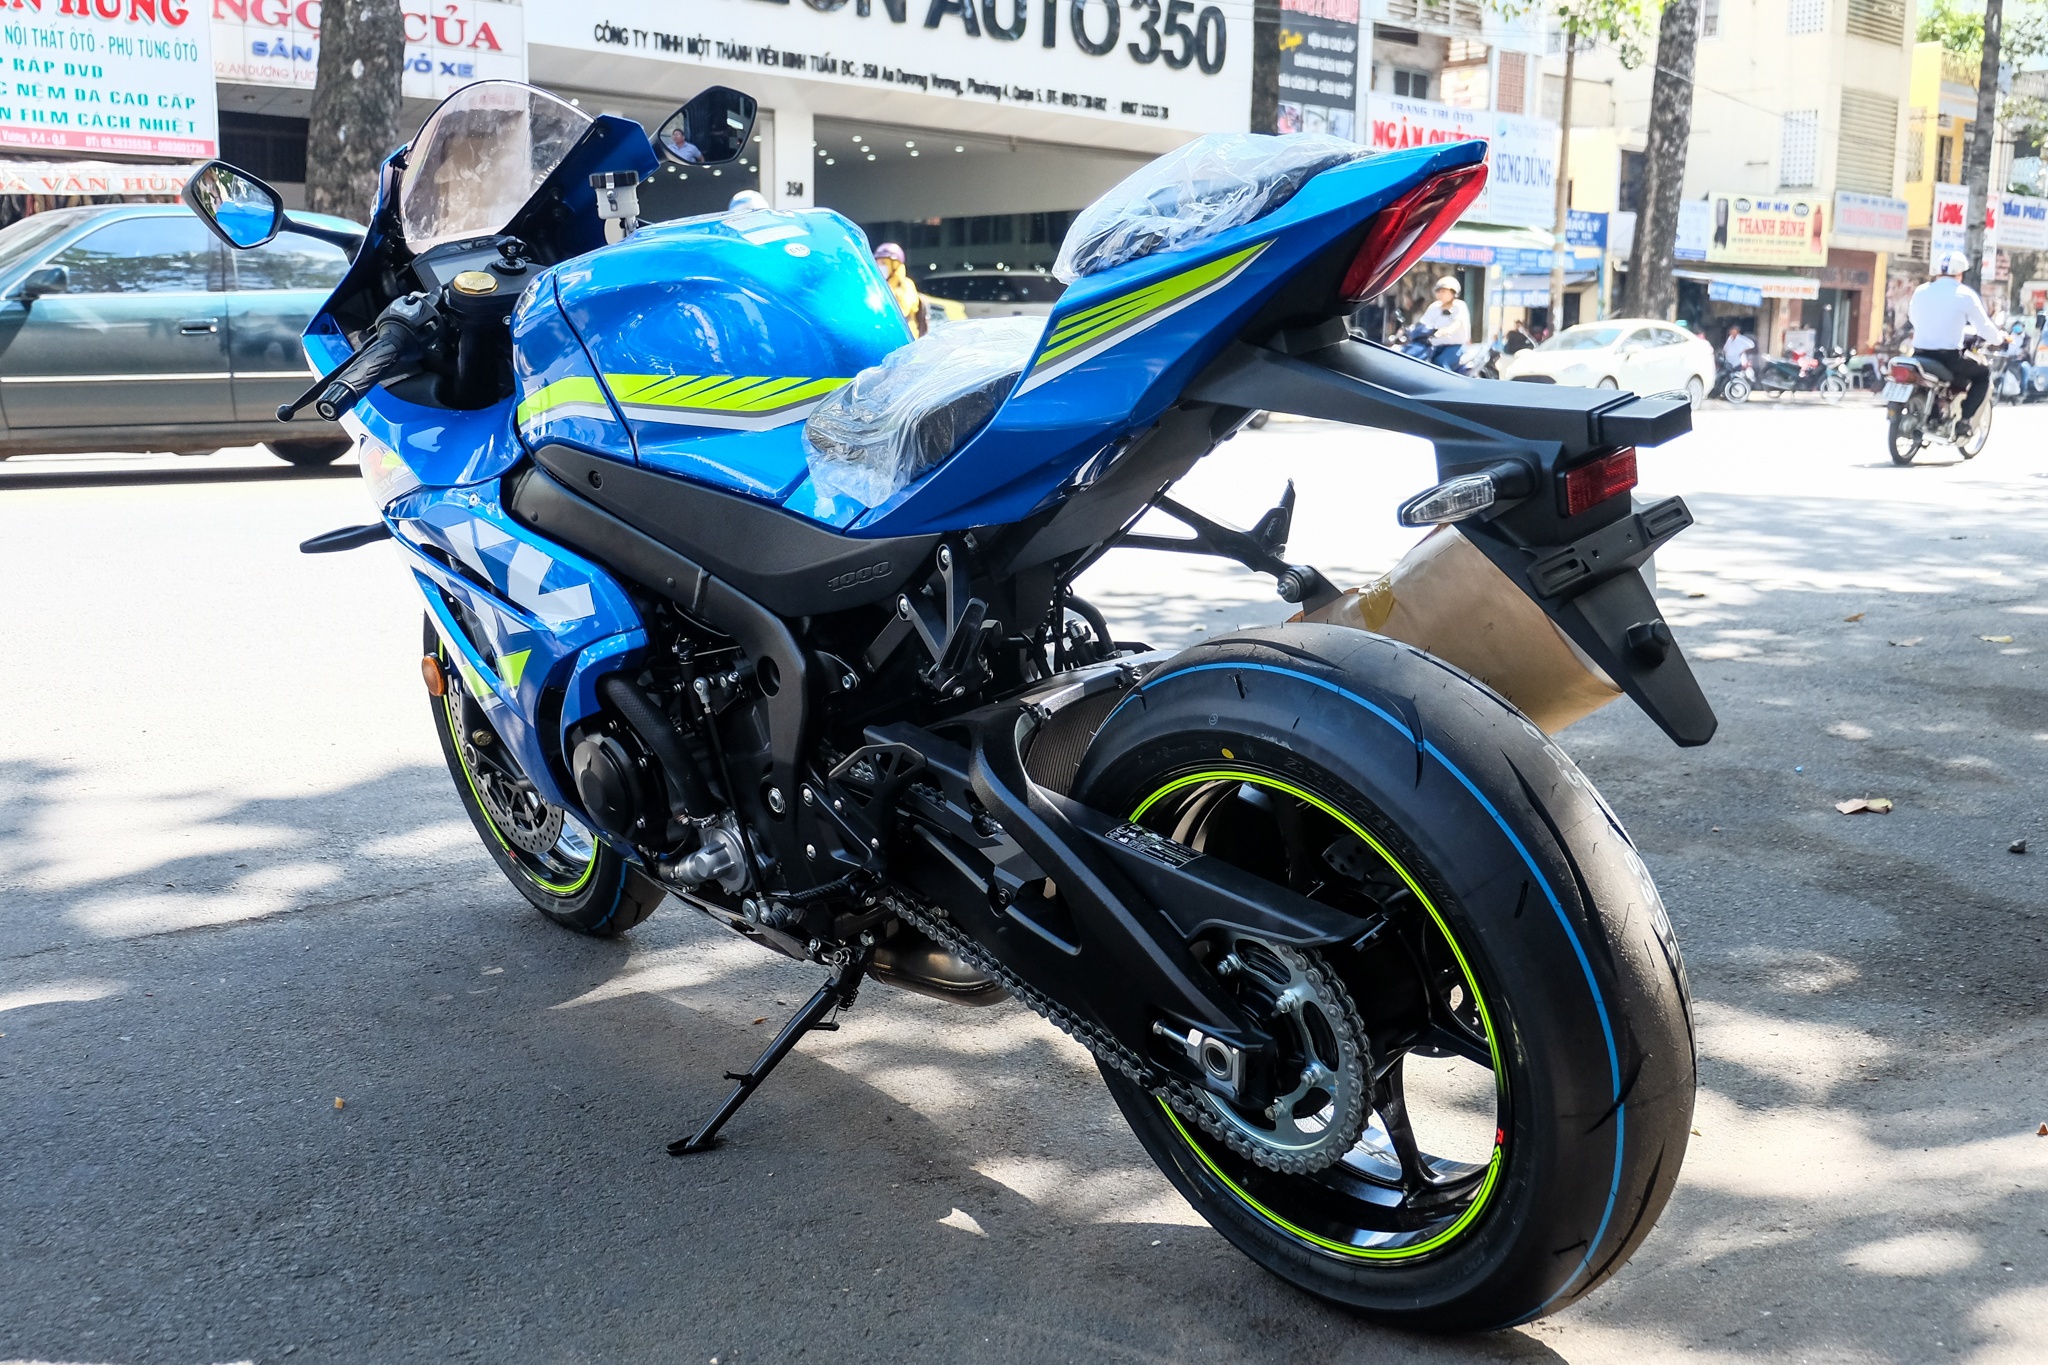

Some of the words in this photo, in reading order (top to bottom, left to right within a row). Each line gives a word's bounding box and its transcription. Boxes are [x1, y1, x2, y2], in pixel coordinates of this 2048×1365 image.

[5, 21, 27, 49] NỘI
[32, 21, 64, 49] THẤT
[70, 27, 95, 52] ÔTÔ
[109, 36, 133, 60] PHỤ
[138, 34, 171, 60] TÙNG
[174, 37, 198, 62] ÔTÔ
[403, 4, 503, 51] CỦA
[594, 20, 629, 46] CÔNG
[633, 29, 648, 49] TY
[653, 32, 684, 53] TNHH
[715, 38, 752, 62] THÀNH
[64, 63, 103, 79] DVD
[439, 61, 474, 78] XE
[17, 82, 66, 101] NỆM
[75, 88, 100, 104] DA
[110, 91, 149, 107] CAO
[158, 91, 196, 110] CẤP
[20, 108, 69, 125] FILM
[77, 112, 131, 129] CÁCH
[139, 116, 196, 136] NHIỆT
[40, 174, 110, 191] VĂN
[1737, 218, 1776, 235] THANH
[1779, 217, 1806, 237] BÌNH
[827, 561, 893, 592] 1000
